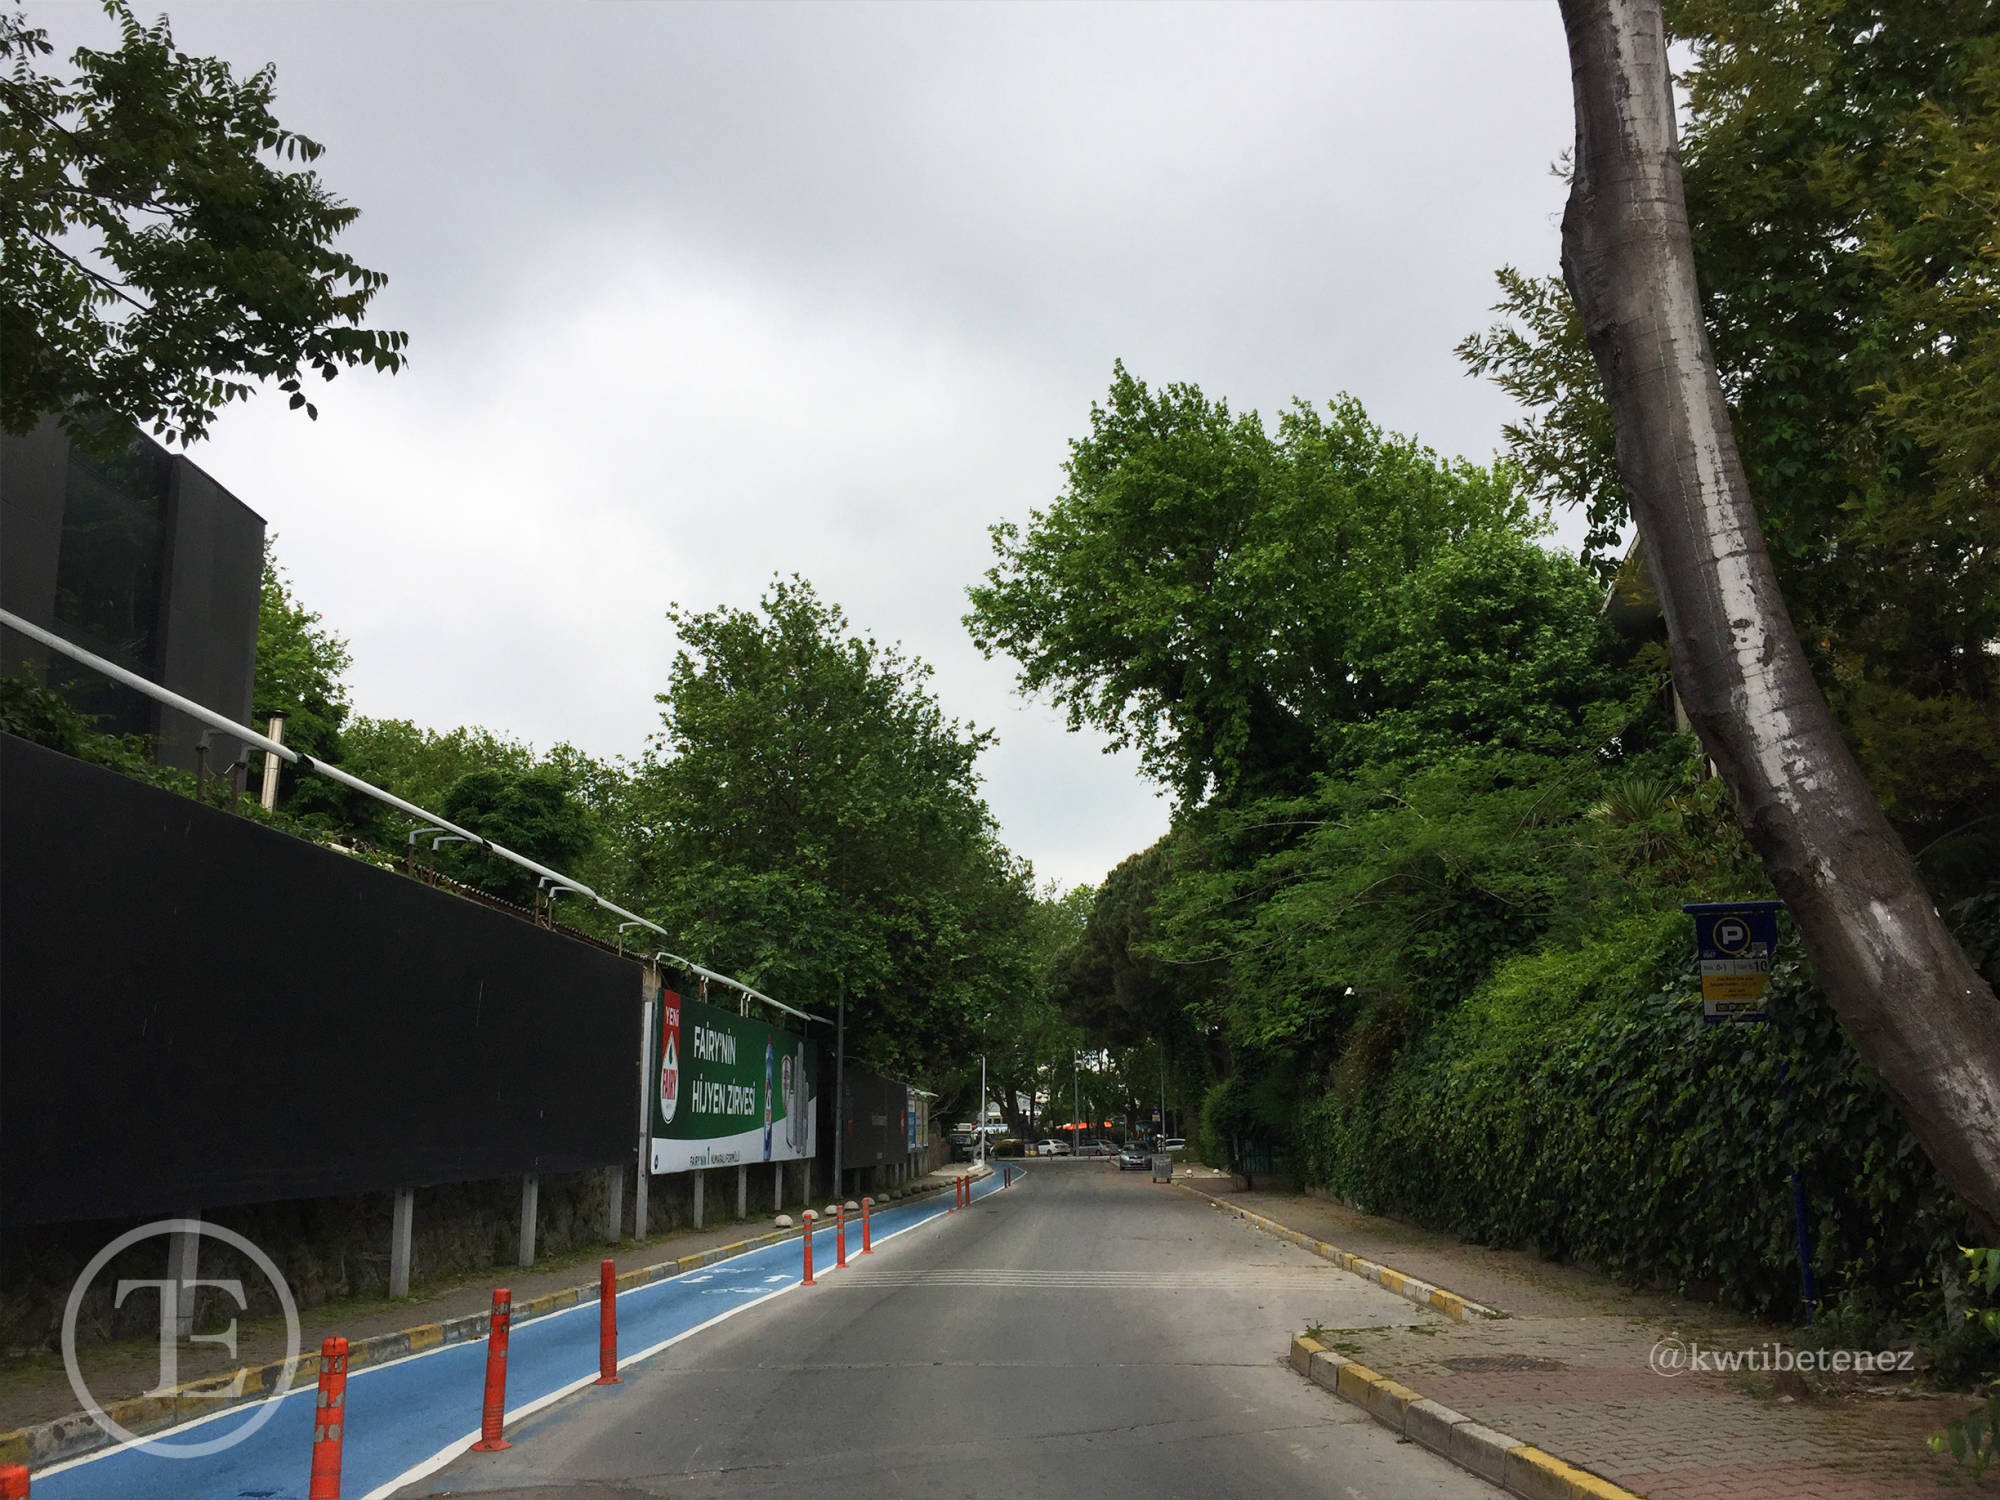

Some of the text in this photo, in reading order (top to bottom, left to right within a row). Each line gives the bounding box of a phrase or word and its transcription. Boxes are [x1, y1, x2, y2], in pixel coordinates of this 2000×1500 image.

[1722, 926, 1743, 945] P
[1754, 960, 1768, 972] 10
[692, 1074, 756, 1116] HİJYEN ZİRVESİ
